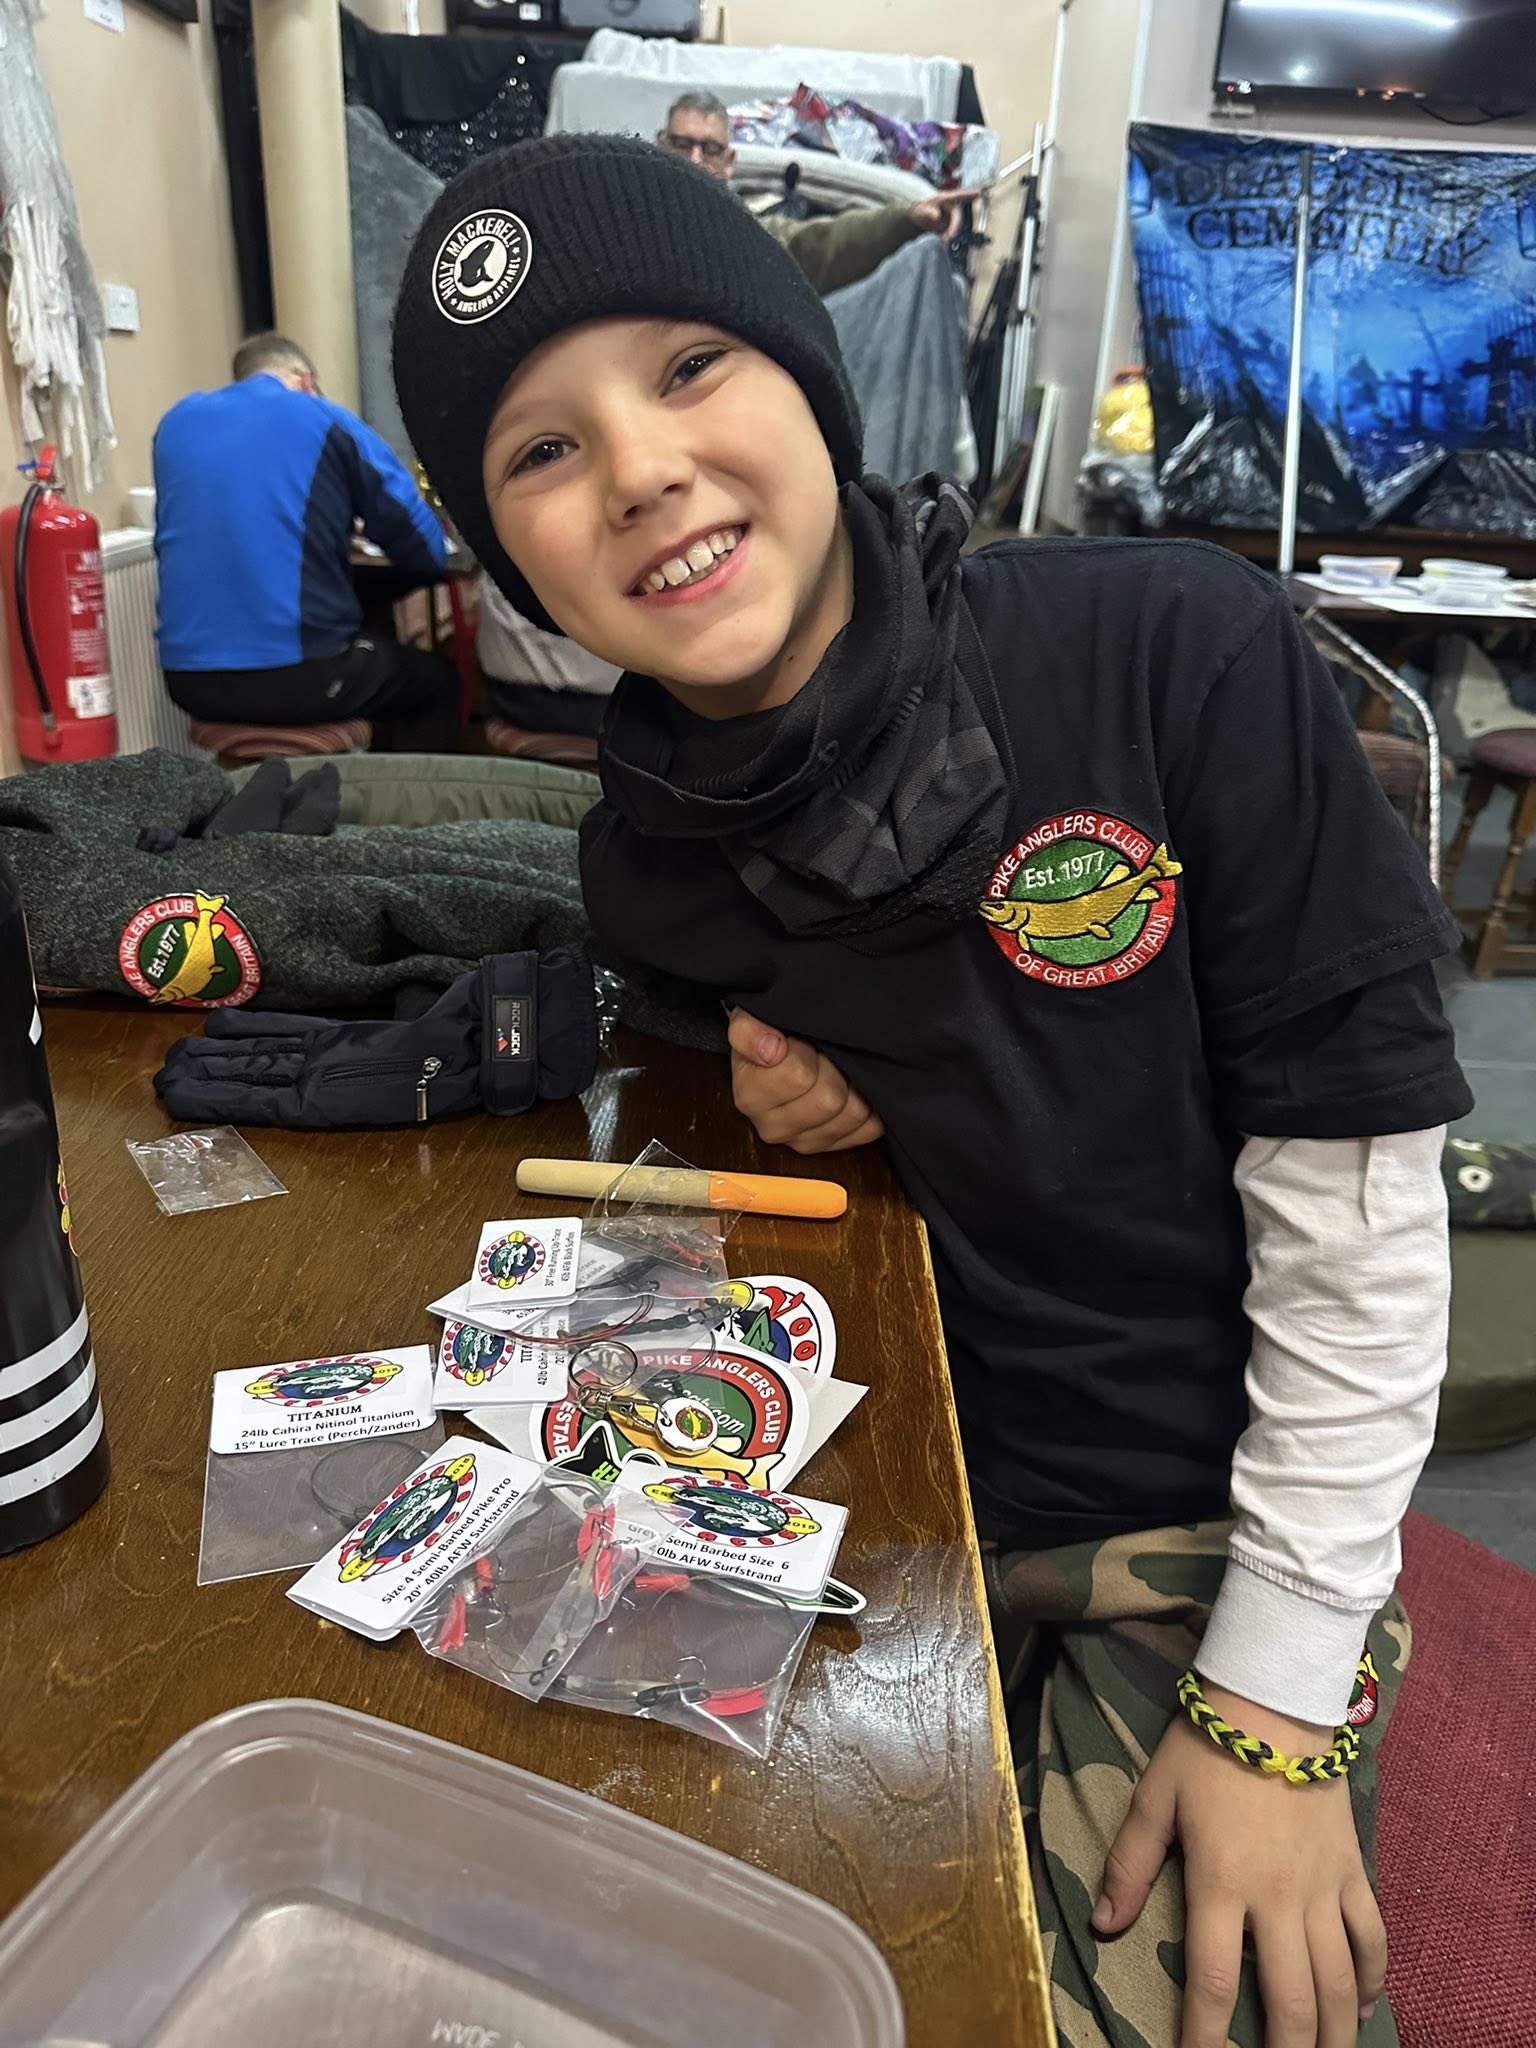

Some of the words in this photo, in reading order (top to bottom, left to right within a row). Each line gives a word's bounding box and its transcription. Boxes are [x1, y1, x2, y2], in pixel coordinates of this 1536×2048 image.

[446, 218, 521, 257] MACKEREL!
[438, 261, 457, 300] HOLY
[456, 295, 494, 312] ANGLING
[492, 257, 521, 300] APPAREL
[991, 856, 1020, 898] PIKE
[1020, 814, 1097, 859] ANGLERS
[1100, 821, 1148, 860] CLUB
[1060, 850, 1105, 881] 1977
[124, 911, 155, 968] ANGLERS
[155, 901, 194, 917] CLUB
[232, 934, 260, 983] BRITAIN
[1016, 953, 1046, 973] OF
[1043, 966, 1107, 986] GREAT
[1112, 915, 1169, 975] BRITAIN
[758, 1286, 817, 1361] VOO
[241, 1428, 268, 1438] 24lb
[272, 1424, 312, 1436] Cahira
[315, 1418, 357, 1430] Nitinol
[360, 1409, 414, 1424] Titanium
[287, 1405, 363, 1422] TITANIUM
[642, 1355, 692, 1366] PIKE
[699, 1357, 775, 1400] ANGLERS
[762, 1399, 782, 1444] CLUB
[259, 1437, 286, 1448] Lure
[290, 1434, 324, 1445] Trace
[328, 1418, 421, 1442] (Perch/Zander)
[552, 1402, 577, 1457] ESTAB
[382, 1583, 406, 1604] Size
[404, 1577, 414, 1587] 4
[414, 1517, 473, 1577] Semi-Barbed
[472, 1495, 495, 1517] Pike
[492, 1477, 512, 1496] Pro
[425, 1564, 449, 1585] 40lb
[450, 1540, 473, 1563] AFW
[471, 1490, 520, 1542] Surfstrand
[666, 1536, 697, 1550] Semi
[700, 1544, 746, 1562] Barbed
[750, 1555, 774, 1567] Size
[781, 1560, 790, 1570] 6
[675, 1554, 711, 1568] AFW
[714, 1560, 782, 1584] Surfstrand
[1347, 1693, 1375, 1720] RITAIN
